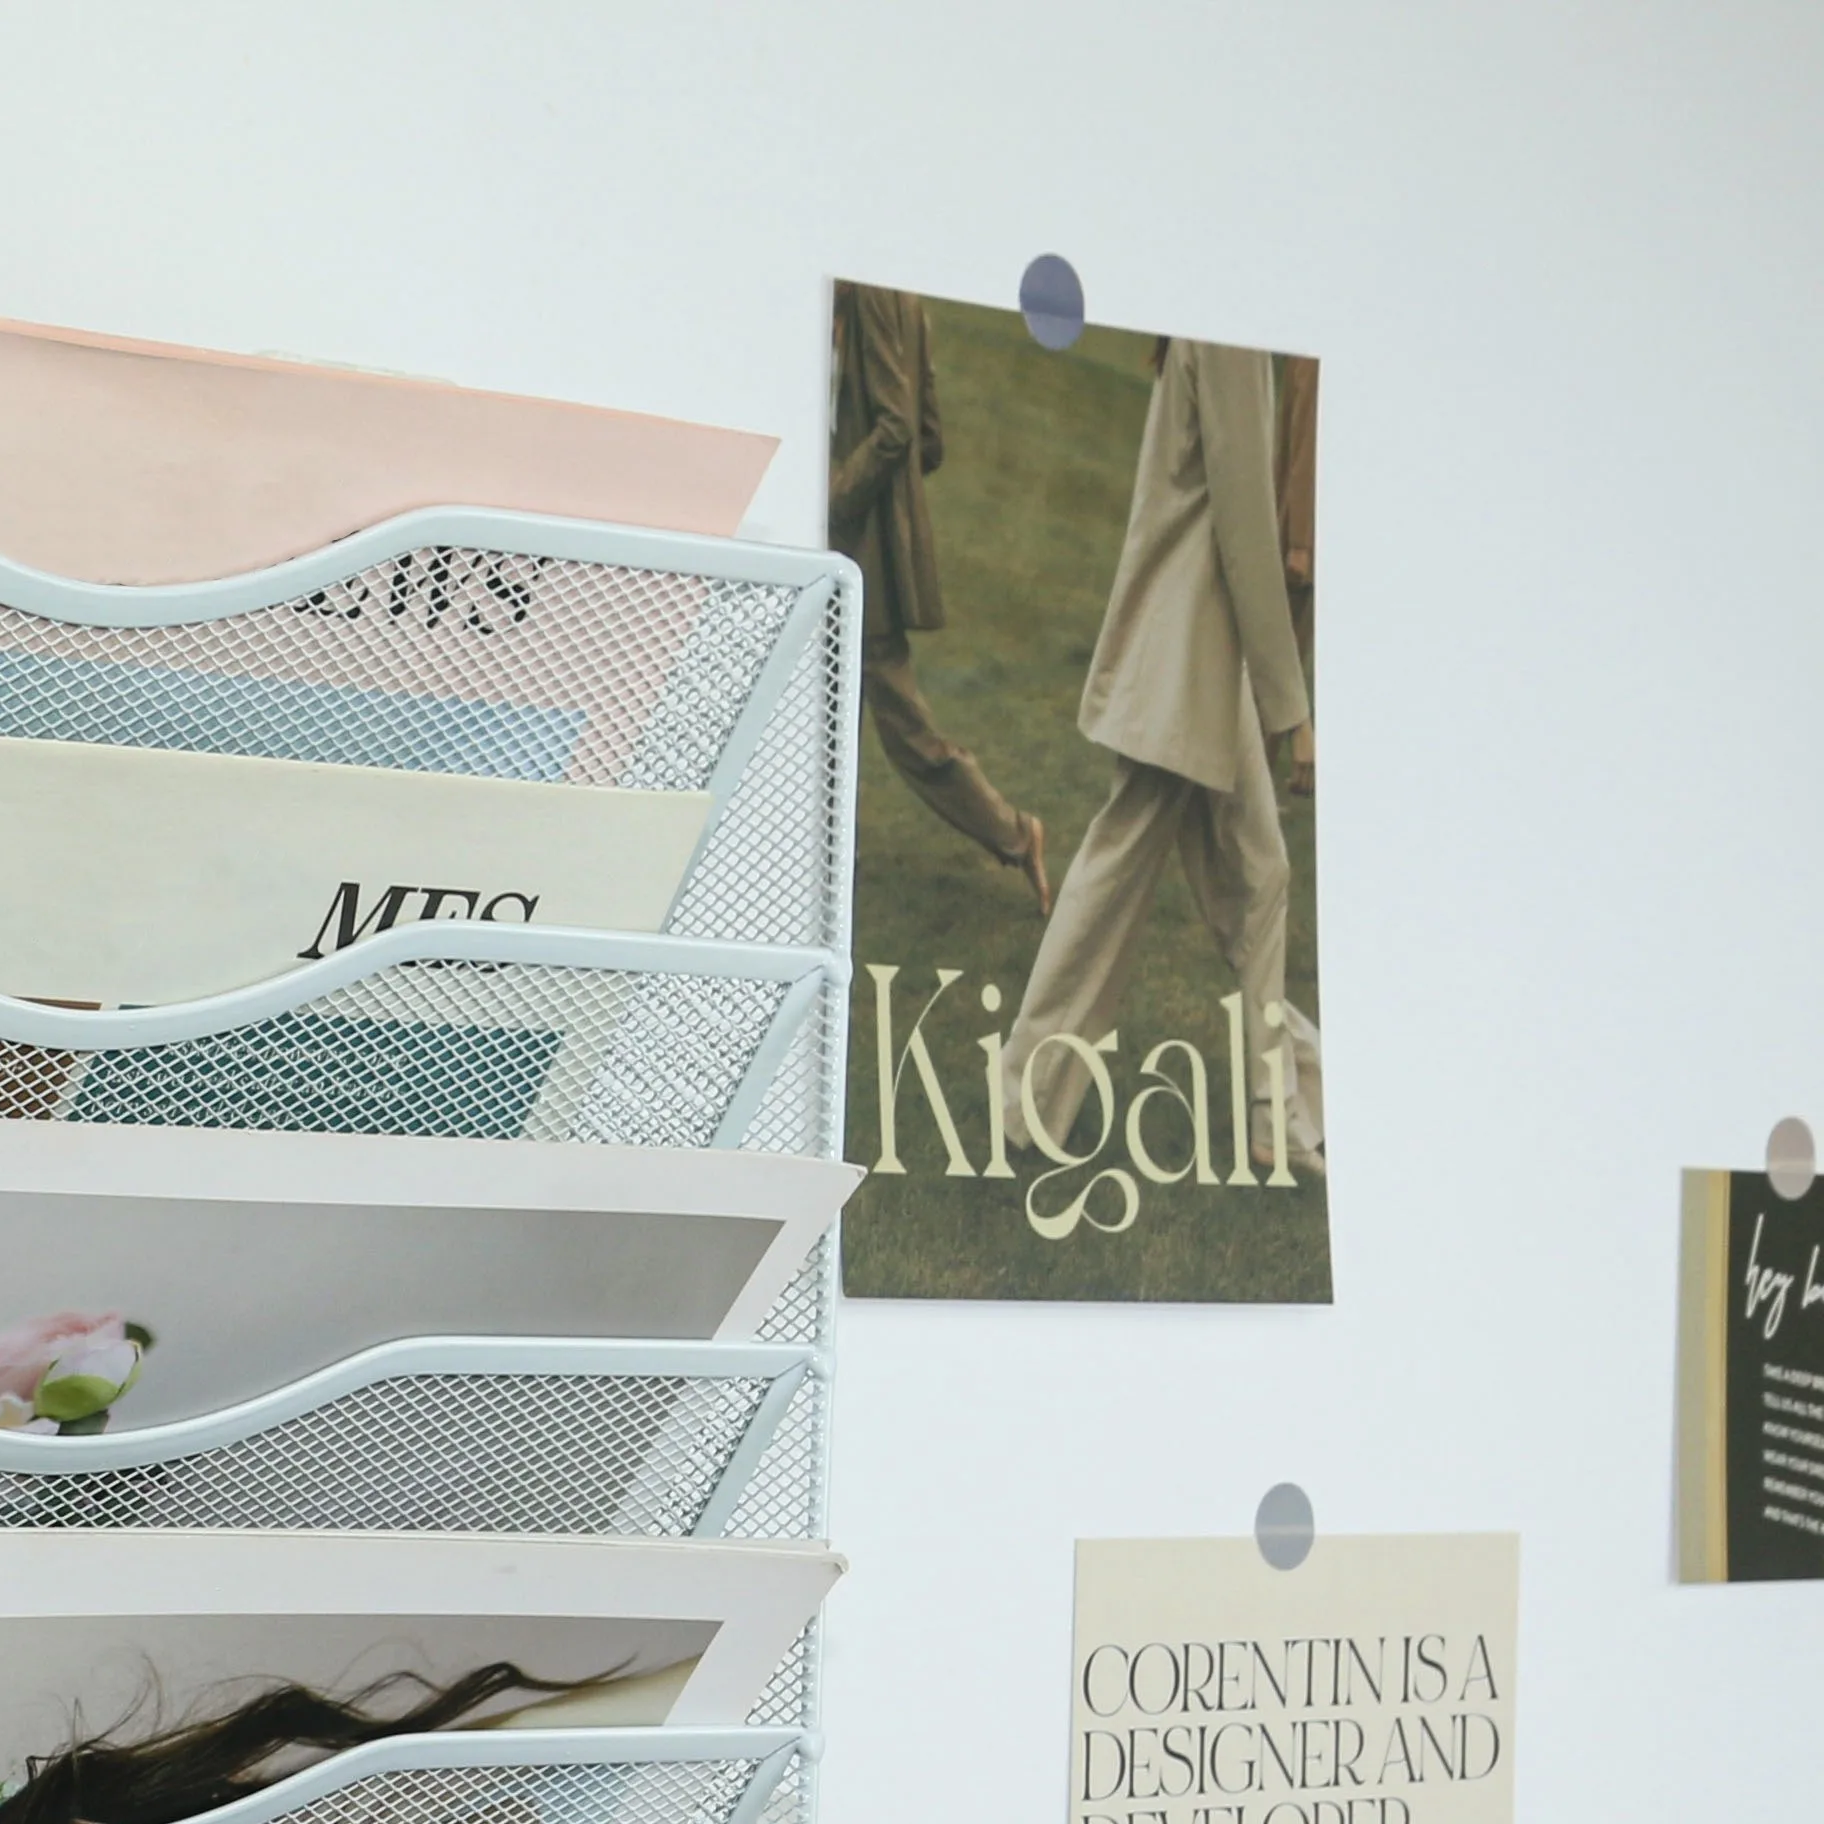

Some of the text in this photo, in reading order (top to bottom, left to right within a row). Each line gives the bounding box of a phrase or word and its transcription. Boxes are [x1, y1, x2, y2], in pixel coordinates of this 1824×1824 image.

[865, 963, 1299, 1240] Kigali
[1745, 1212, 1795, 1340] hey
[1082, 1633, 1500, 1718] CORENTIN IS A
[1081, 1713, 1501, 1802] DESIGNER AND
